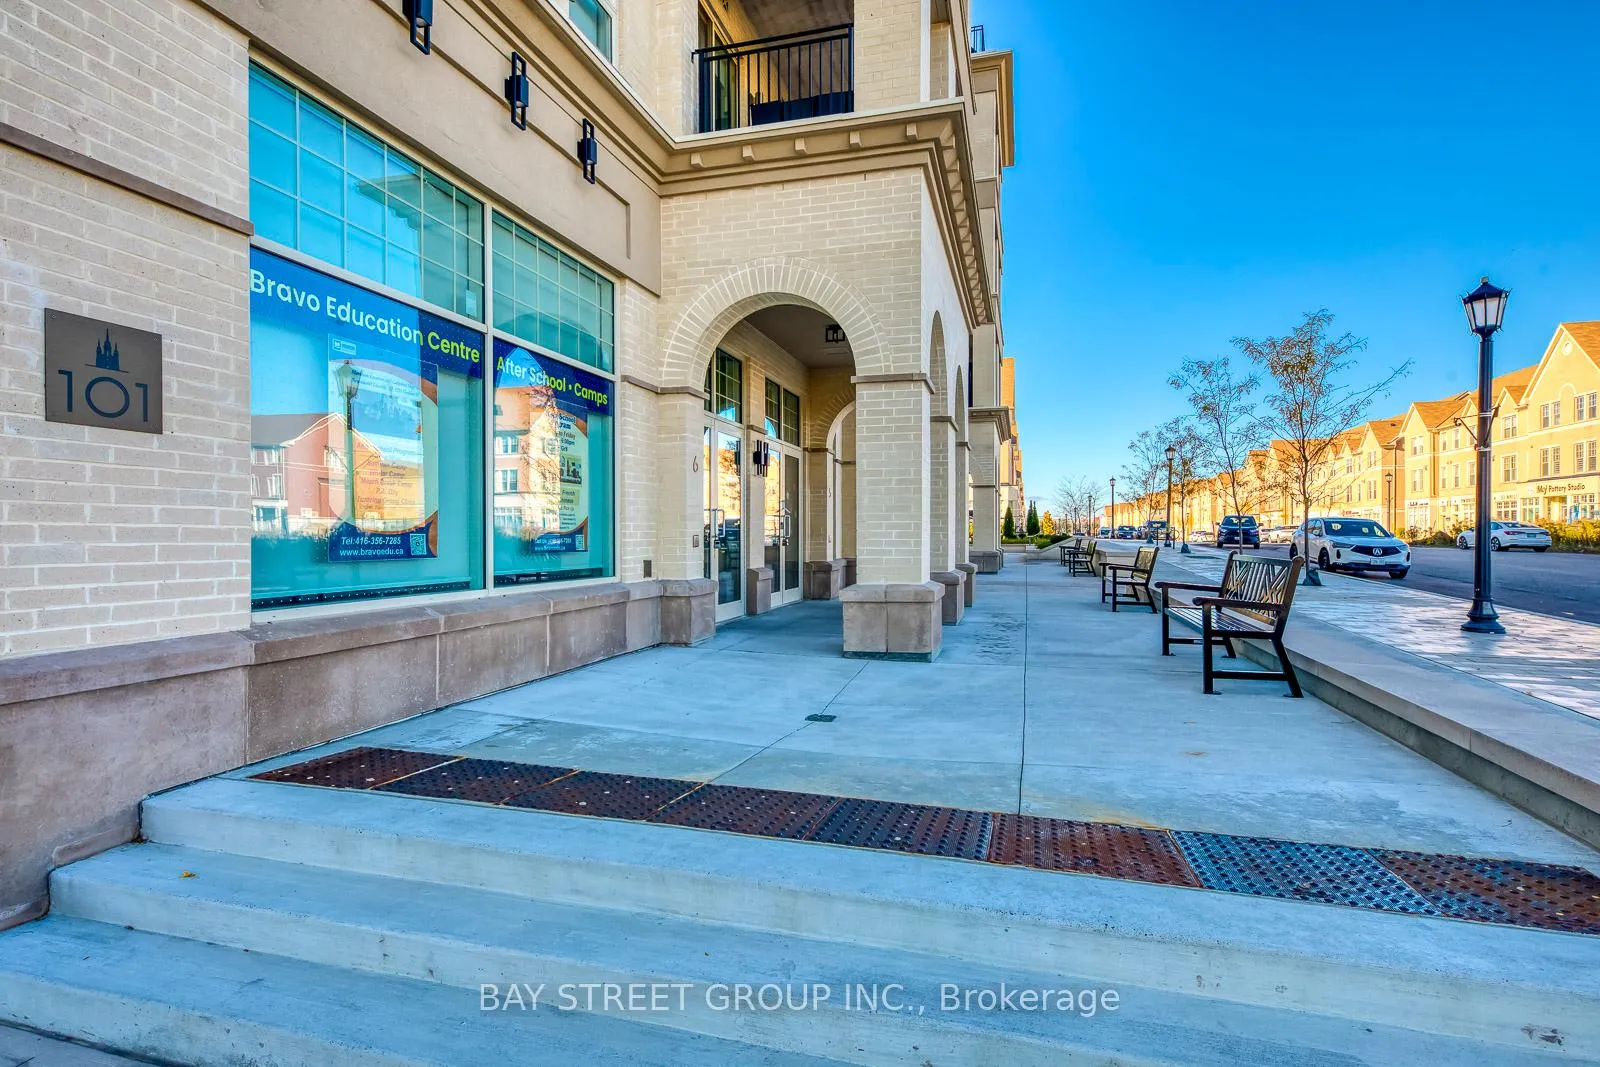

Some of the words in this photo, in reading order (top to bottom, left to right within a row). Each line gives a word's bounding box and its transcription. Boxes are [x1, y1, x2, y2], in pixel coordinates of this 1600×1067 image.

[250, 268, 321, 312] Bravo
[326, 295, 424, 346] Education
[427, 331, 480, 363] Centre
[58, 369, 149, 422] 101
[496, 356, 527, 379] After
[529, 368, 566, 392] School
[574, 383, 608, 406] Camps
[692, 455, 698, 472] 6
